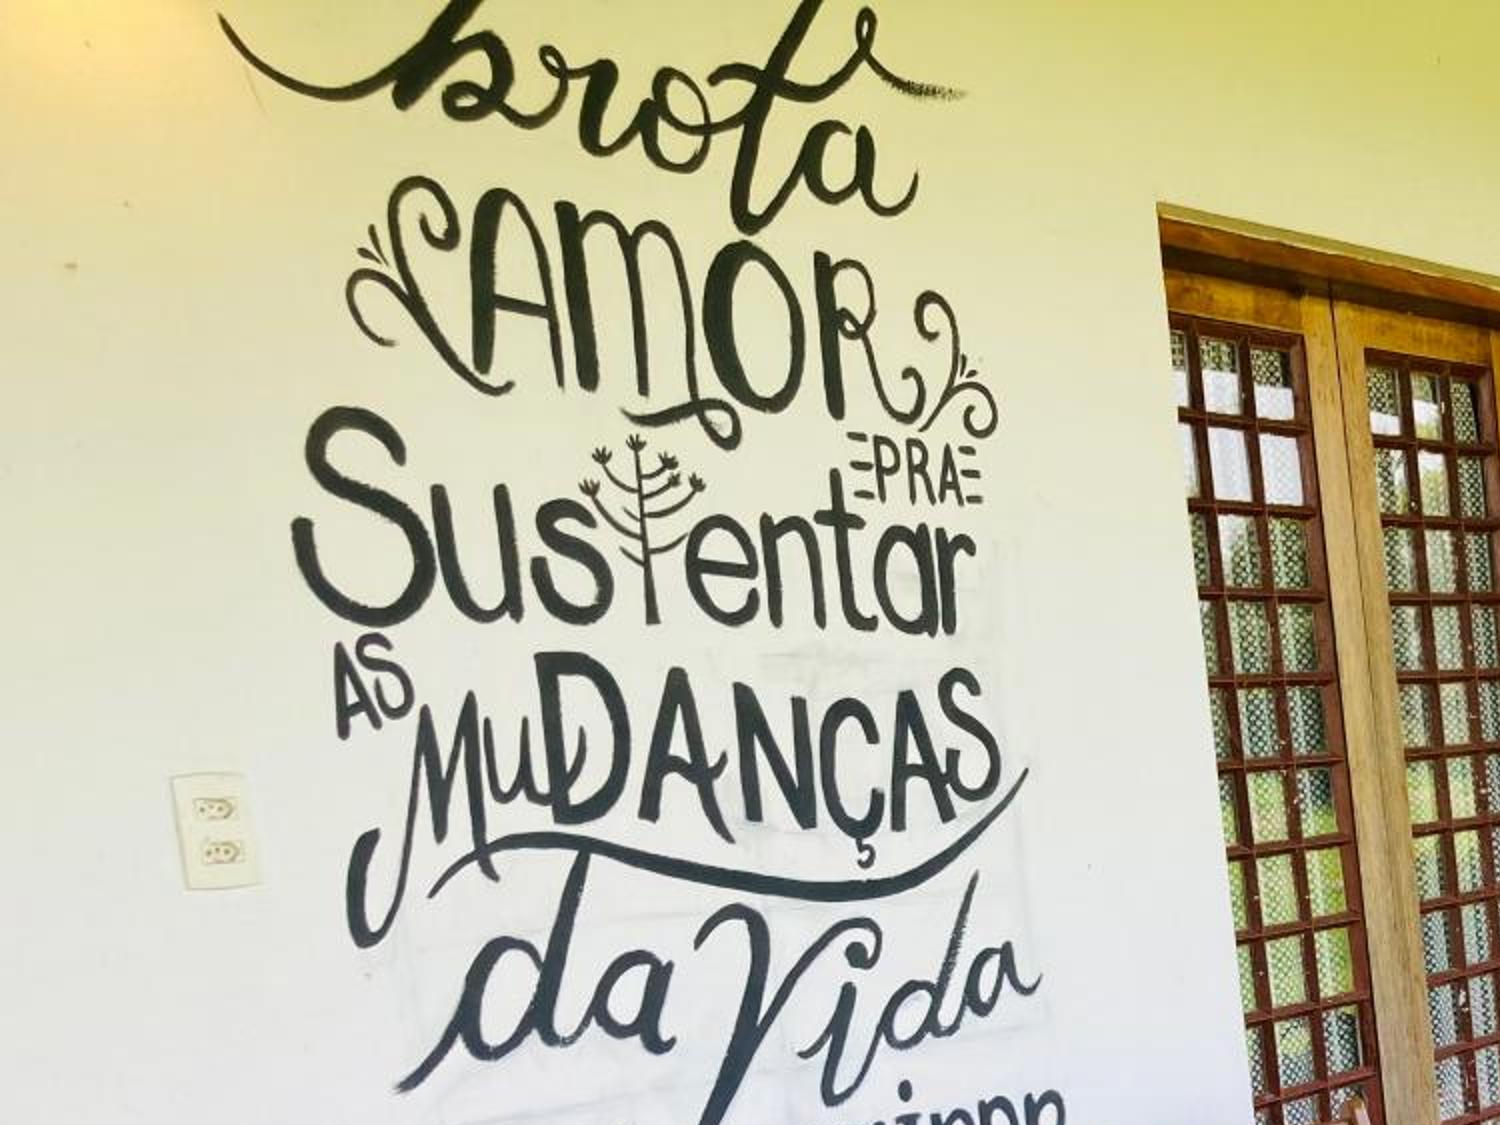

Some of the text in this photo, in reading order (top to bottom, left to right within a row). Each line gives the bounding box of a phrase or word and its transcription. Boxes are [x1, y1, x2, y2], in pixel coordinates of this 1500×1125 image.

[219, 0, 966, 236] brota
[872, 433, 966, 508] PRA
[334, 632, 416, 742] AS
[393, 850, 679, 1095] da
